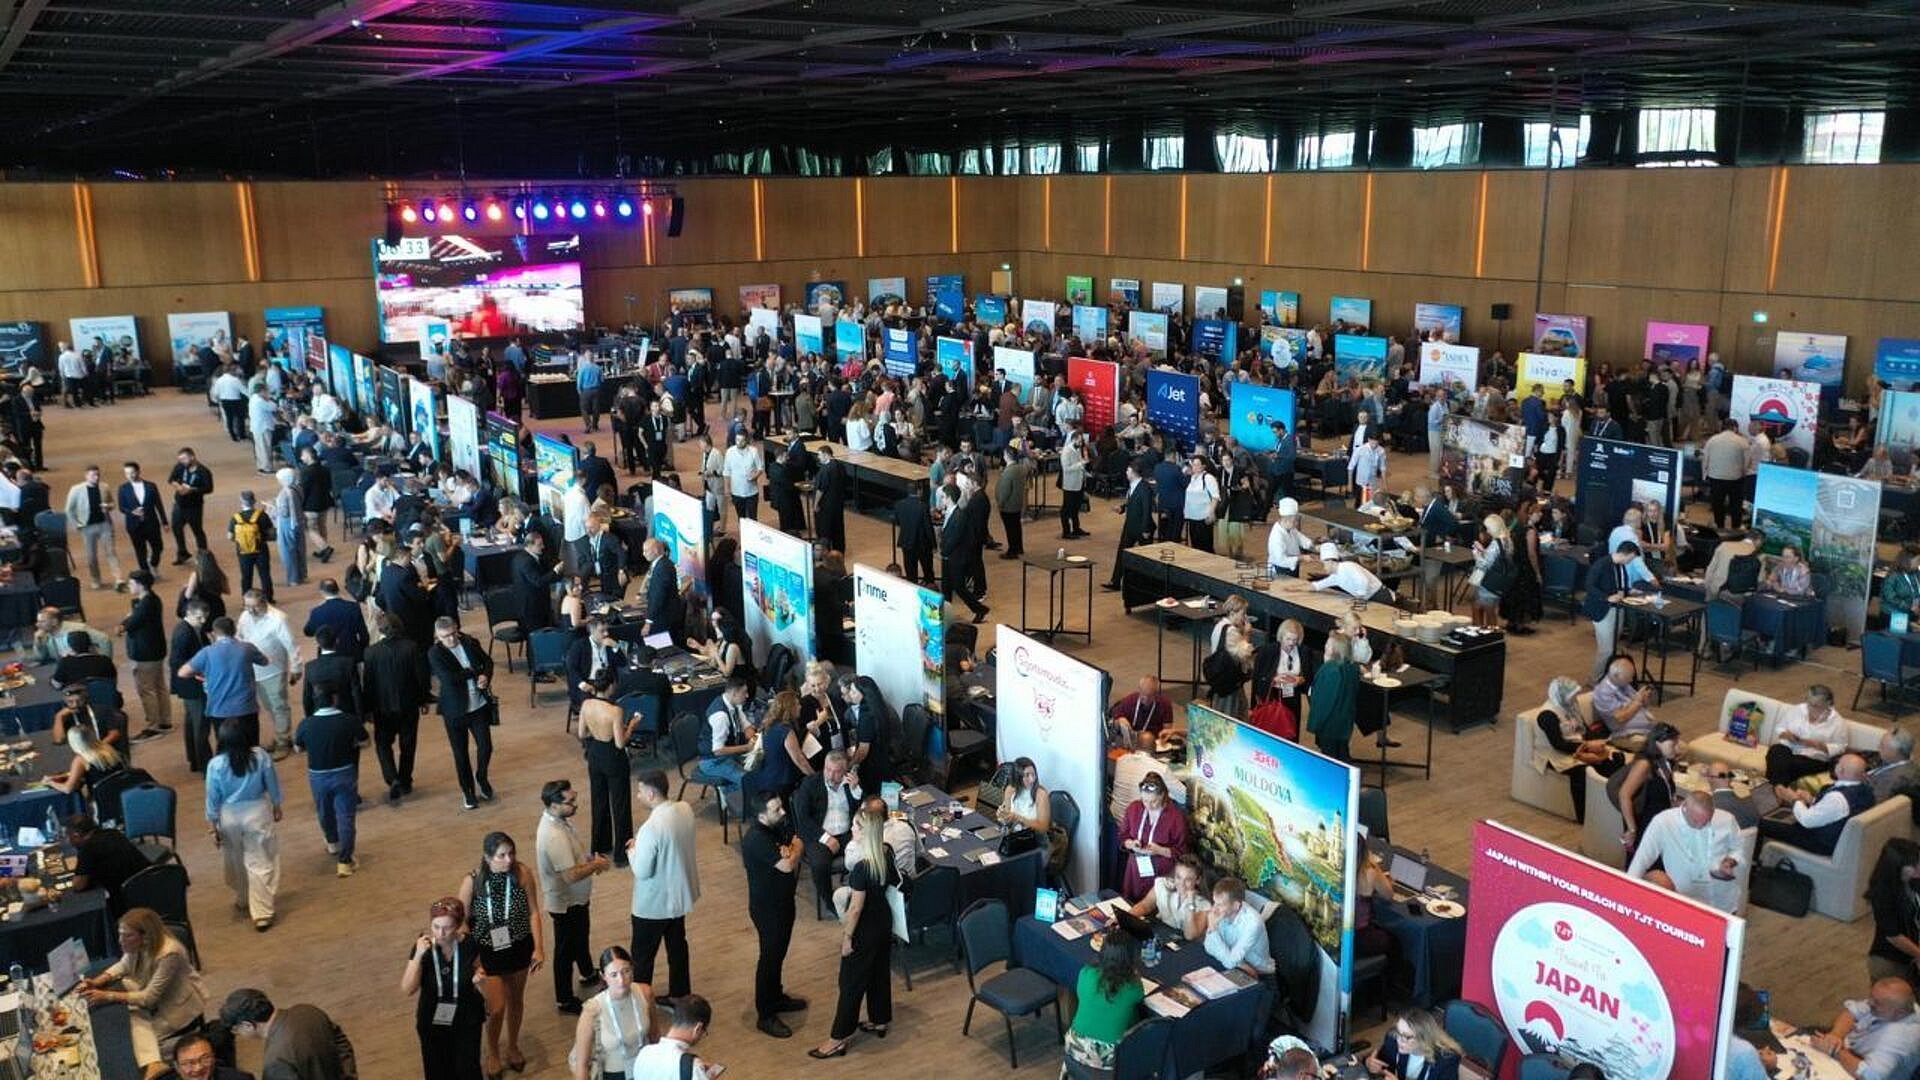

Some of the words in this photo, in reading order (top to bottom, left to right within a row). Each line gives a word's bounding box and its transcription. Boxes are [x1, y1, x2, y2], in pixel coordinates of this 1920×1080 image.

[1233, 765, 1292, 803] MOLDOVA
[1485, 847, 1517, 867] JAPAN
[1517, 860, 1551, 881] WITHIN
[1551, 876, 1581, 896] YOUR
[1580, 887, 1617, 911] REACH
[1616, 903, 1634, 918] BY
[1633, 909, 1654, 926] TJT
[1654, 918, 1705, 947] TOURISM
[1536, 960, 1620, 1020] JAPAN
